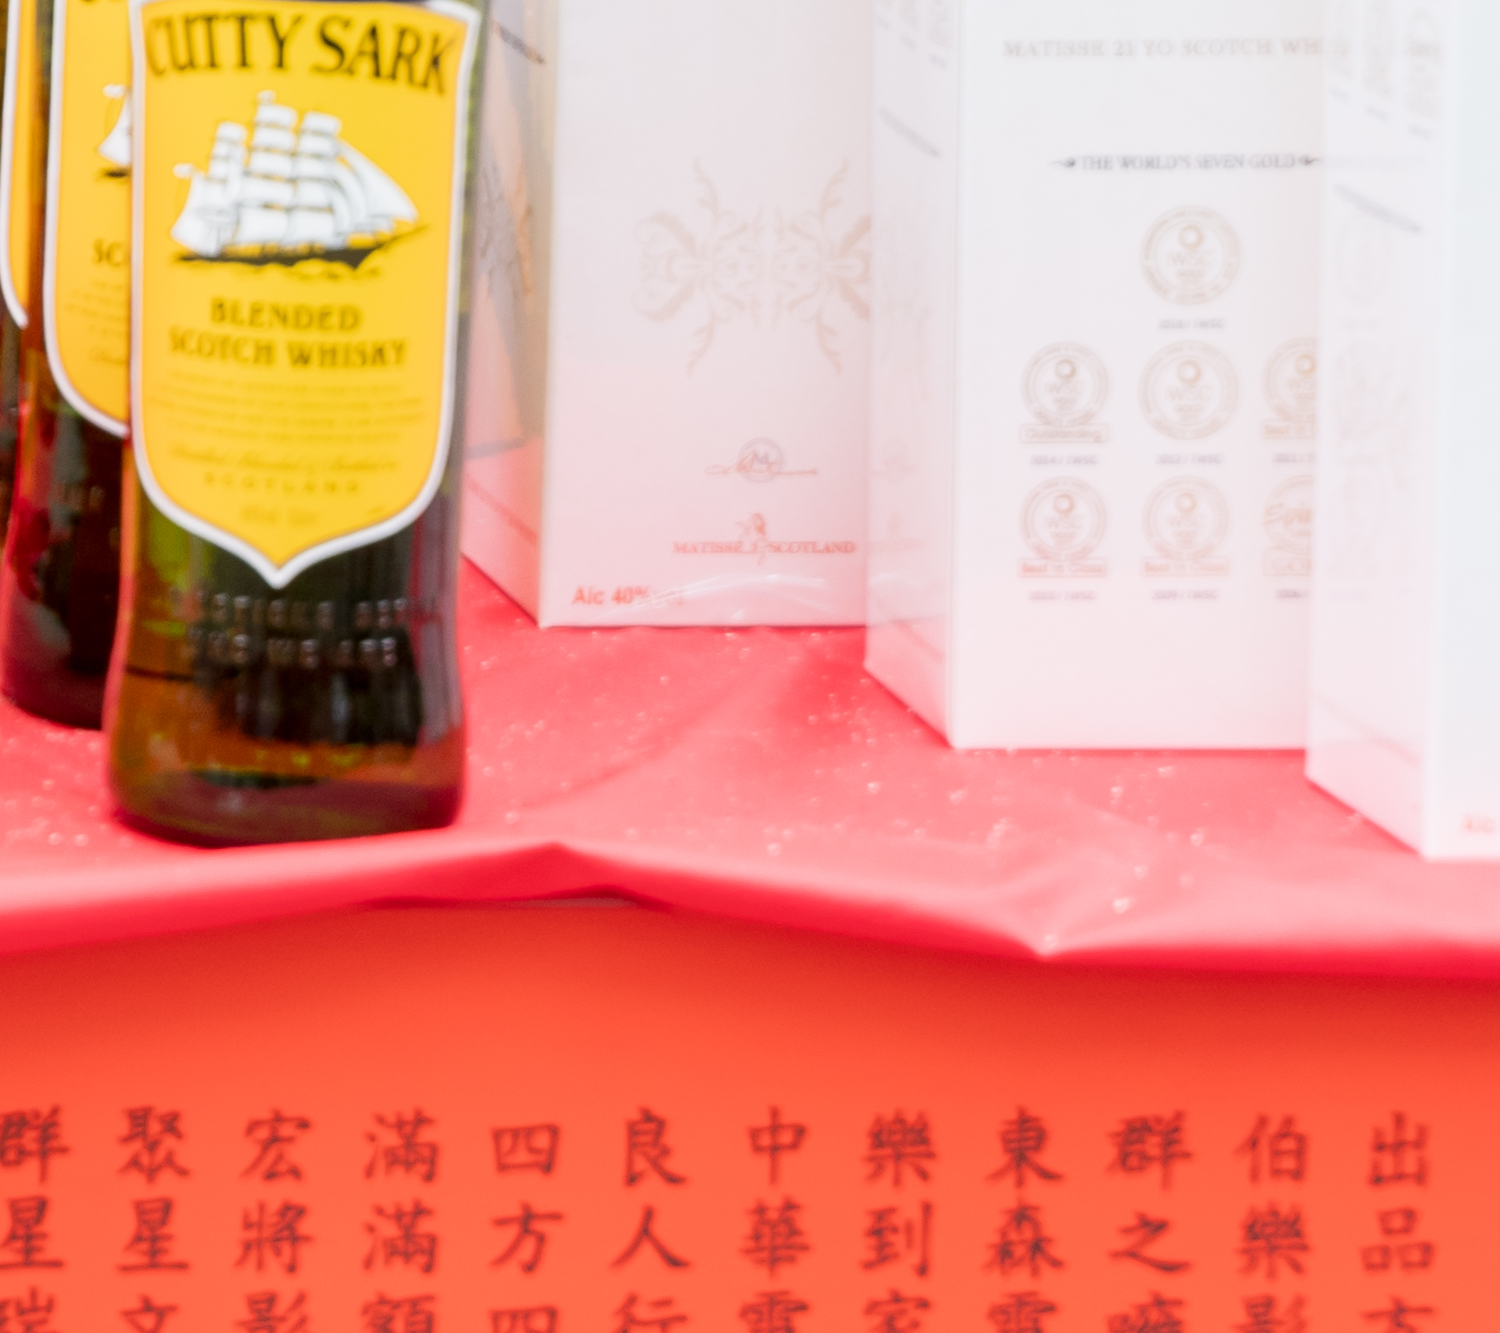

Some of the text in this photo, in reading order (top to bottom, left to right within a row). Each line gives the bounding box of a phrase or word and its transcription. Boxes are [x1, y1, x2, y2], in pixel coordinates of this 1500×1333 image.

[145, 12, 456, 96] CUTTY SARK
[1003, 40, 1104, 58] MATISSE
[1112, 40, 1134, 56] 21
[1143, 39, 1174, 56] YO
[1181, 38, 1273, 56] SCOTCH
[210, 296, 362, 332] BLENDED
[169, 325, 409, 370] SCOTCH WHISKY
[573, 585, 603, 605] Alc
